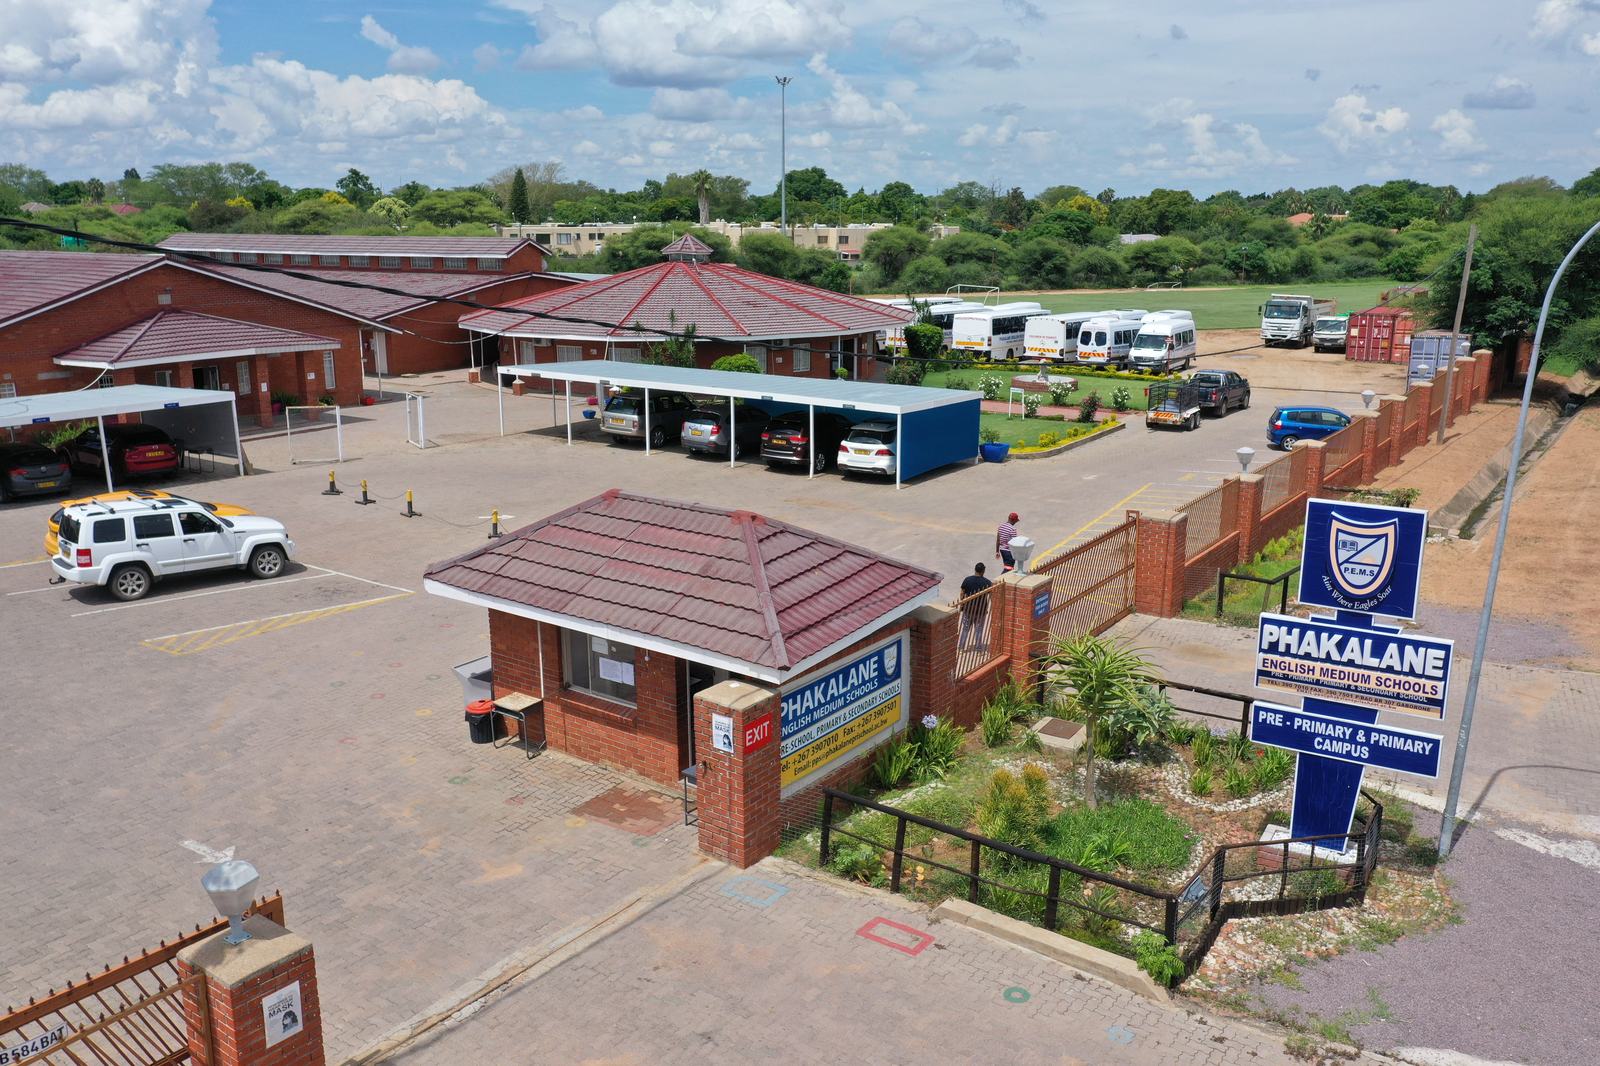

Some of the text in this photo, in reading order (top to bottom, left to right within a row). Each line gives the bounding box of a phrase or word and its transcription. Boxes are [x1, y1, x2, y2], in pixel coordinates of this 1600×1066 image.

[1343, 567, 1375, 577] P.E.M.S
[1322, 575, 1392, 611] Aim Where Eagles Soar
[1261, 624, 1446, 678] PHAKALANE
[1262, 658, 1438, 696] ENGLISH MEDIUM SCHOOLS
[1357, 686, 1400, 698] SECONDARY
[1399, 693, 1428, 703] SCHOOL
[780, 678, 878, 738] NGLISH MEDIUM SCHOOLS
[780, 682, 900, 756] RE-SCHOOL, PRIMARY & SECONDARY SCHOOLS
[746, 720, 770, 747] EXIT
[780, 700, 897, 773] el: +267 3907010 Fax: +267 3907501
[1259, 710, 1284, 727] PRE
[1294, 717, 1353, 740] PRIMARY
[1356, 729, 1366, 743] &
[1370, 732, 1433, 756] PRIMARY
[1314, 737, 1370, 759] CAMPUS
[268, 1001, 294, 1019] MASK
[11, 1041, 39, 1058] 584
[40, 1026, 65, 1049] BAT
